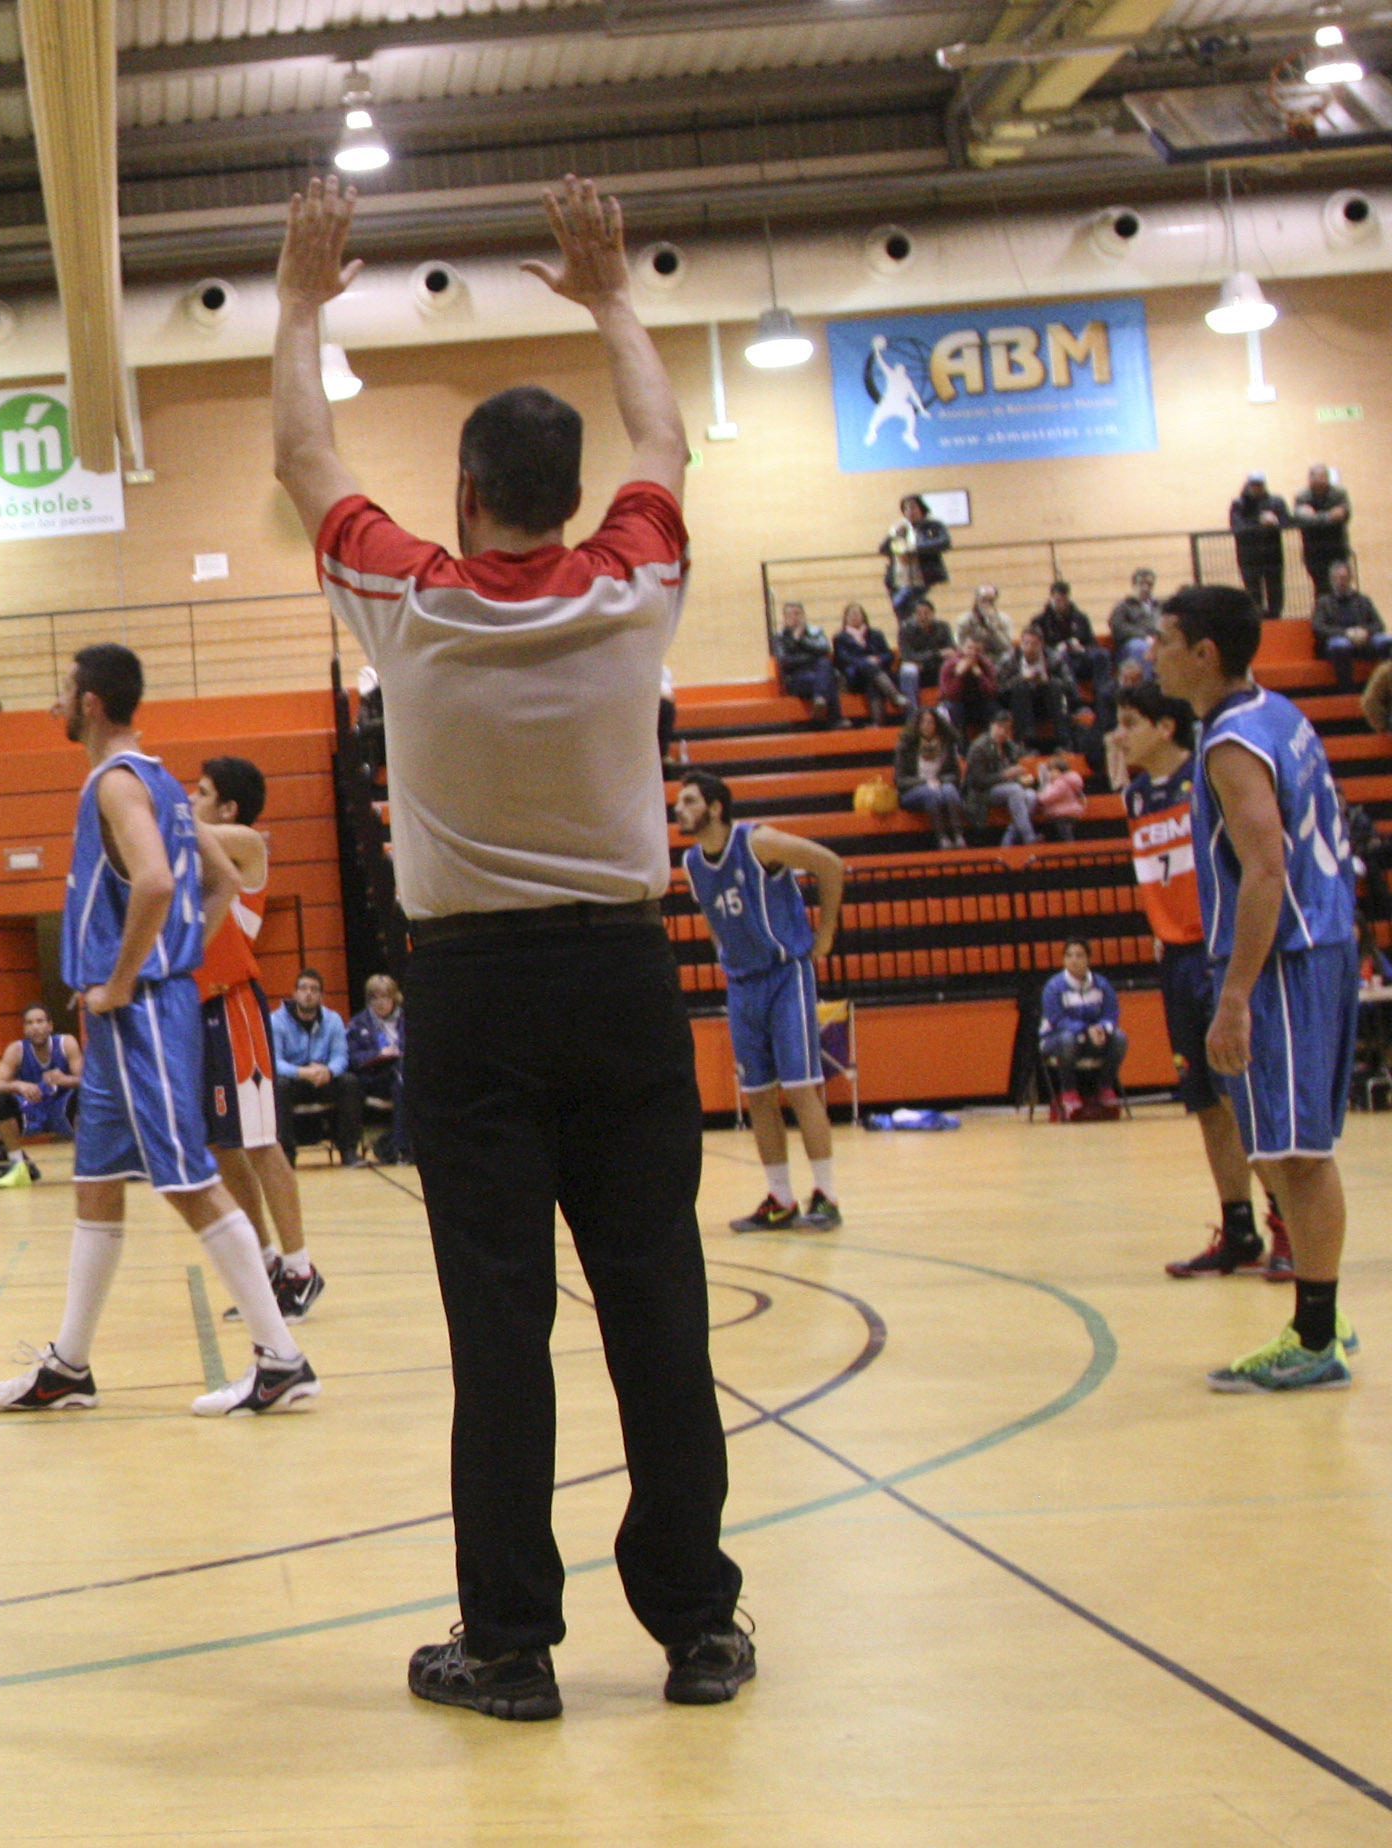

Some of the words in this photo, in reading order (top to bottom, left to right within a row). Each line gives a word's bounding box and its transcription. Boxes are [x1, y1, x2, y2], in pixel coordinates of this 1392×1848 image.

[929, 319, 1112, 403] ABM
[1132, 812, 1192, 851] CBM
[1157, 853, 1170, 884] 7
